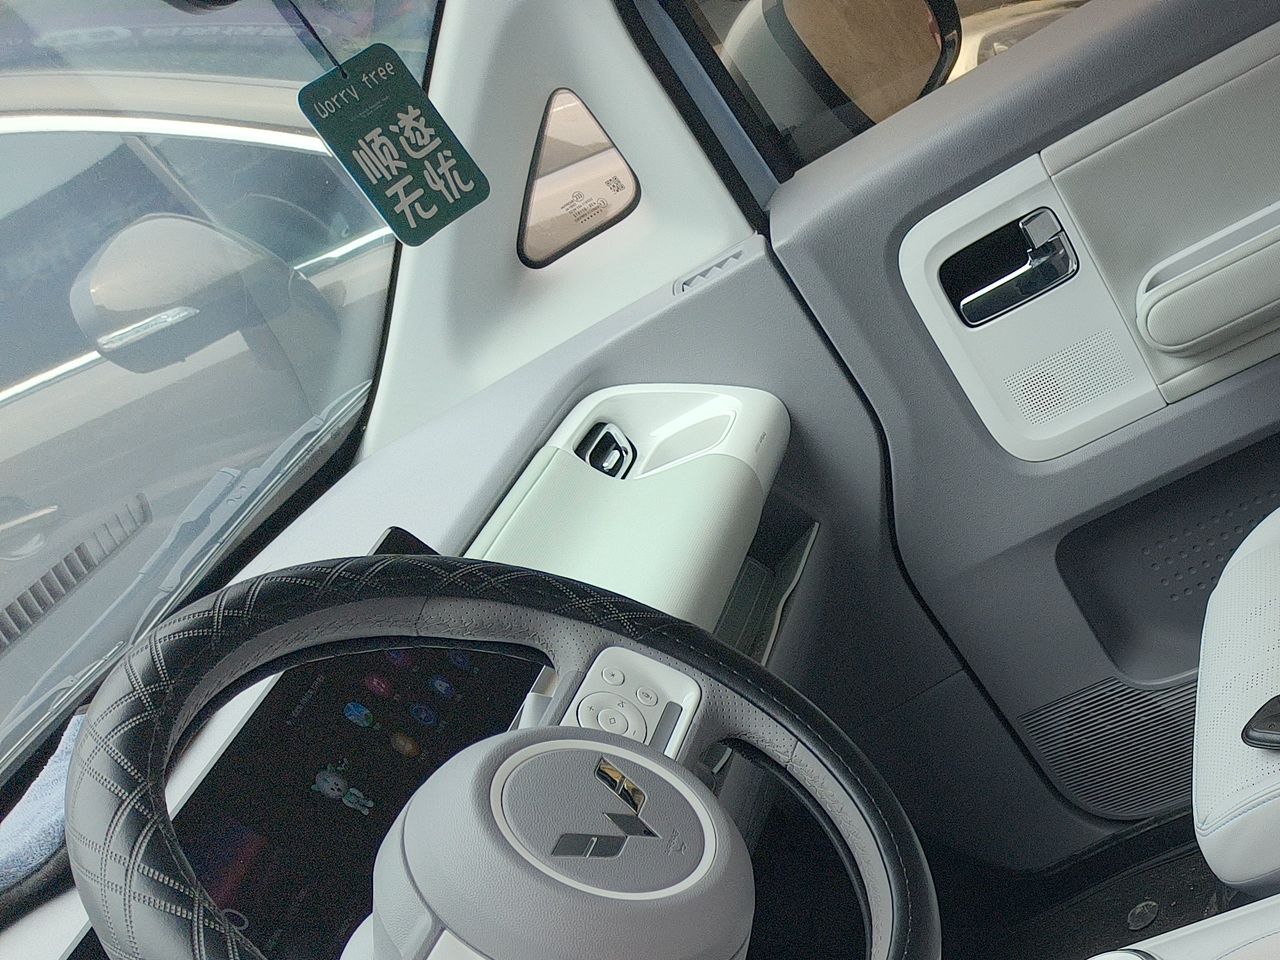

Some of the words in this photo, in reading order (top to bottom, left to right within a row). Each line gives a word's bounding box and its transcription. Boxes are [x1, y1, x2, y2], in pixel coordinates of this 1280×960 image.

[313, 84, 360, 119] Worry
[361, 62, 395, 89] free
[384, 150, 475, 229] 无忧
